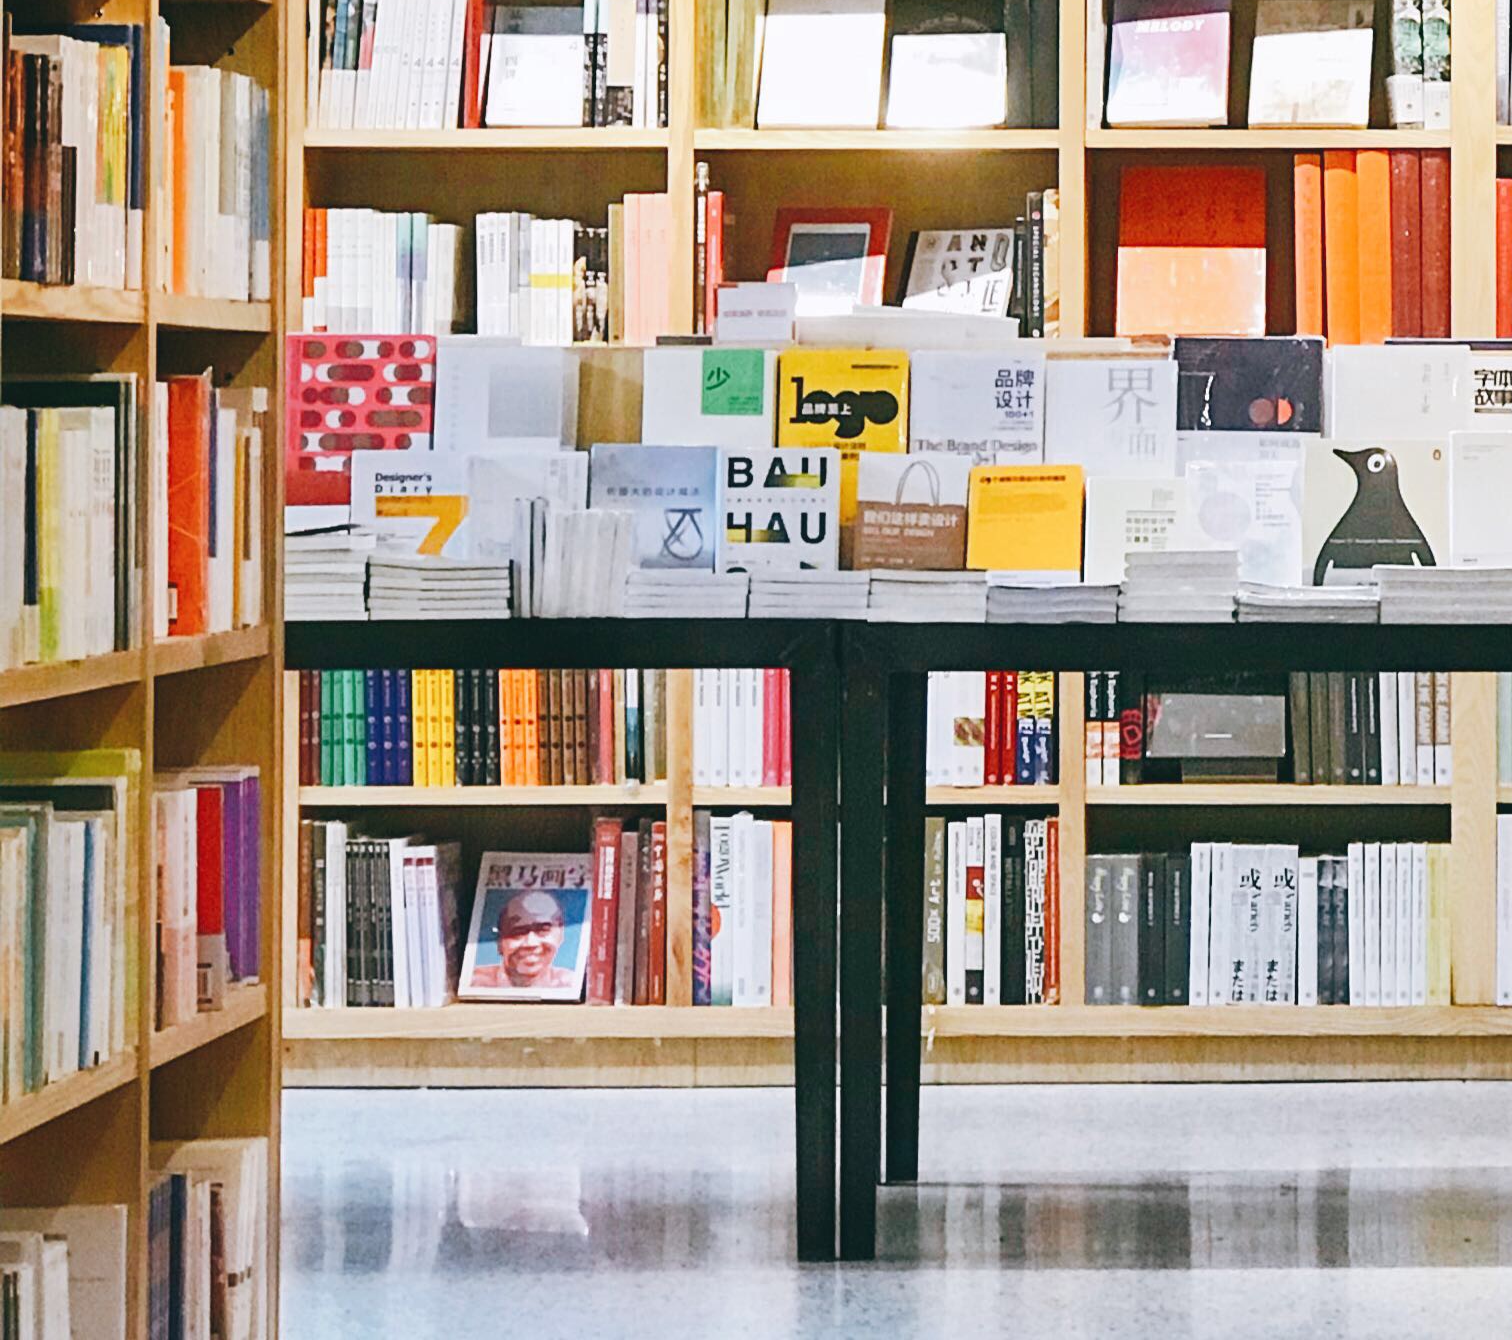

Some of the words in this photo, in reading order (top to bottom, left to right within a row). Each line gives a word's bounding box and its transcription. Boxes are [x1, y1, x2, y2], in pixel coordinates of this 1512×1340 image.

[1136, 20, 1205, 33] MELODY
[706, 366, 731, 391] 少
[994, 369, 1035, 388] 品牌
[1473, 369, 1512, 388] 字体
[789, 376, 899, 439] logo
[994, 390, 1034, 409] 设计
[917, 439, 945, 452] The
[947, 439, 988, 453] Brand
[992, 439, 1038, 454] Design
[374, 472, 433, 485] Designer's
[727, 456, 828, 489] BAU
[726, 511, 827, 545] HAU
[713, 824, 731, 908] LogoWorld
